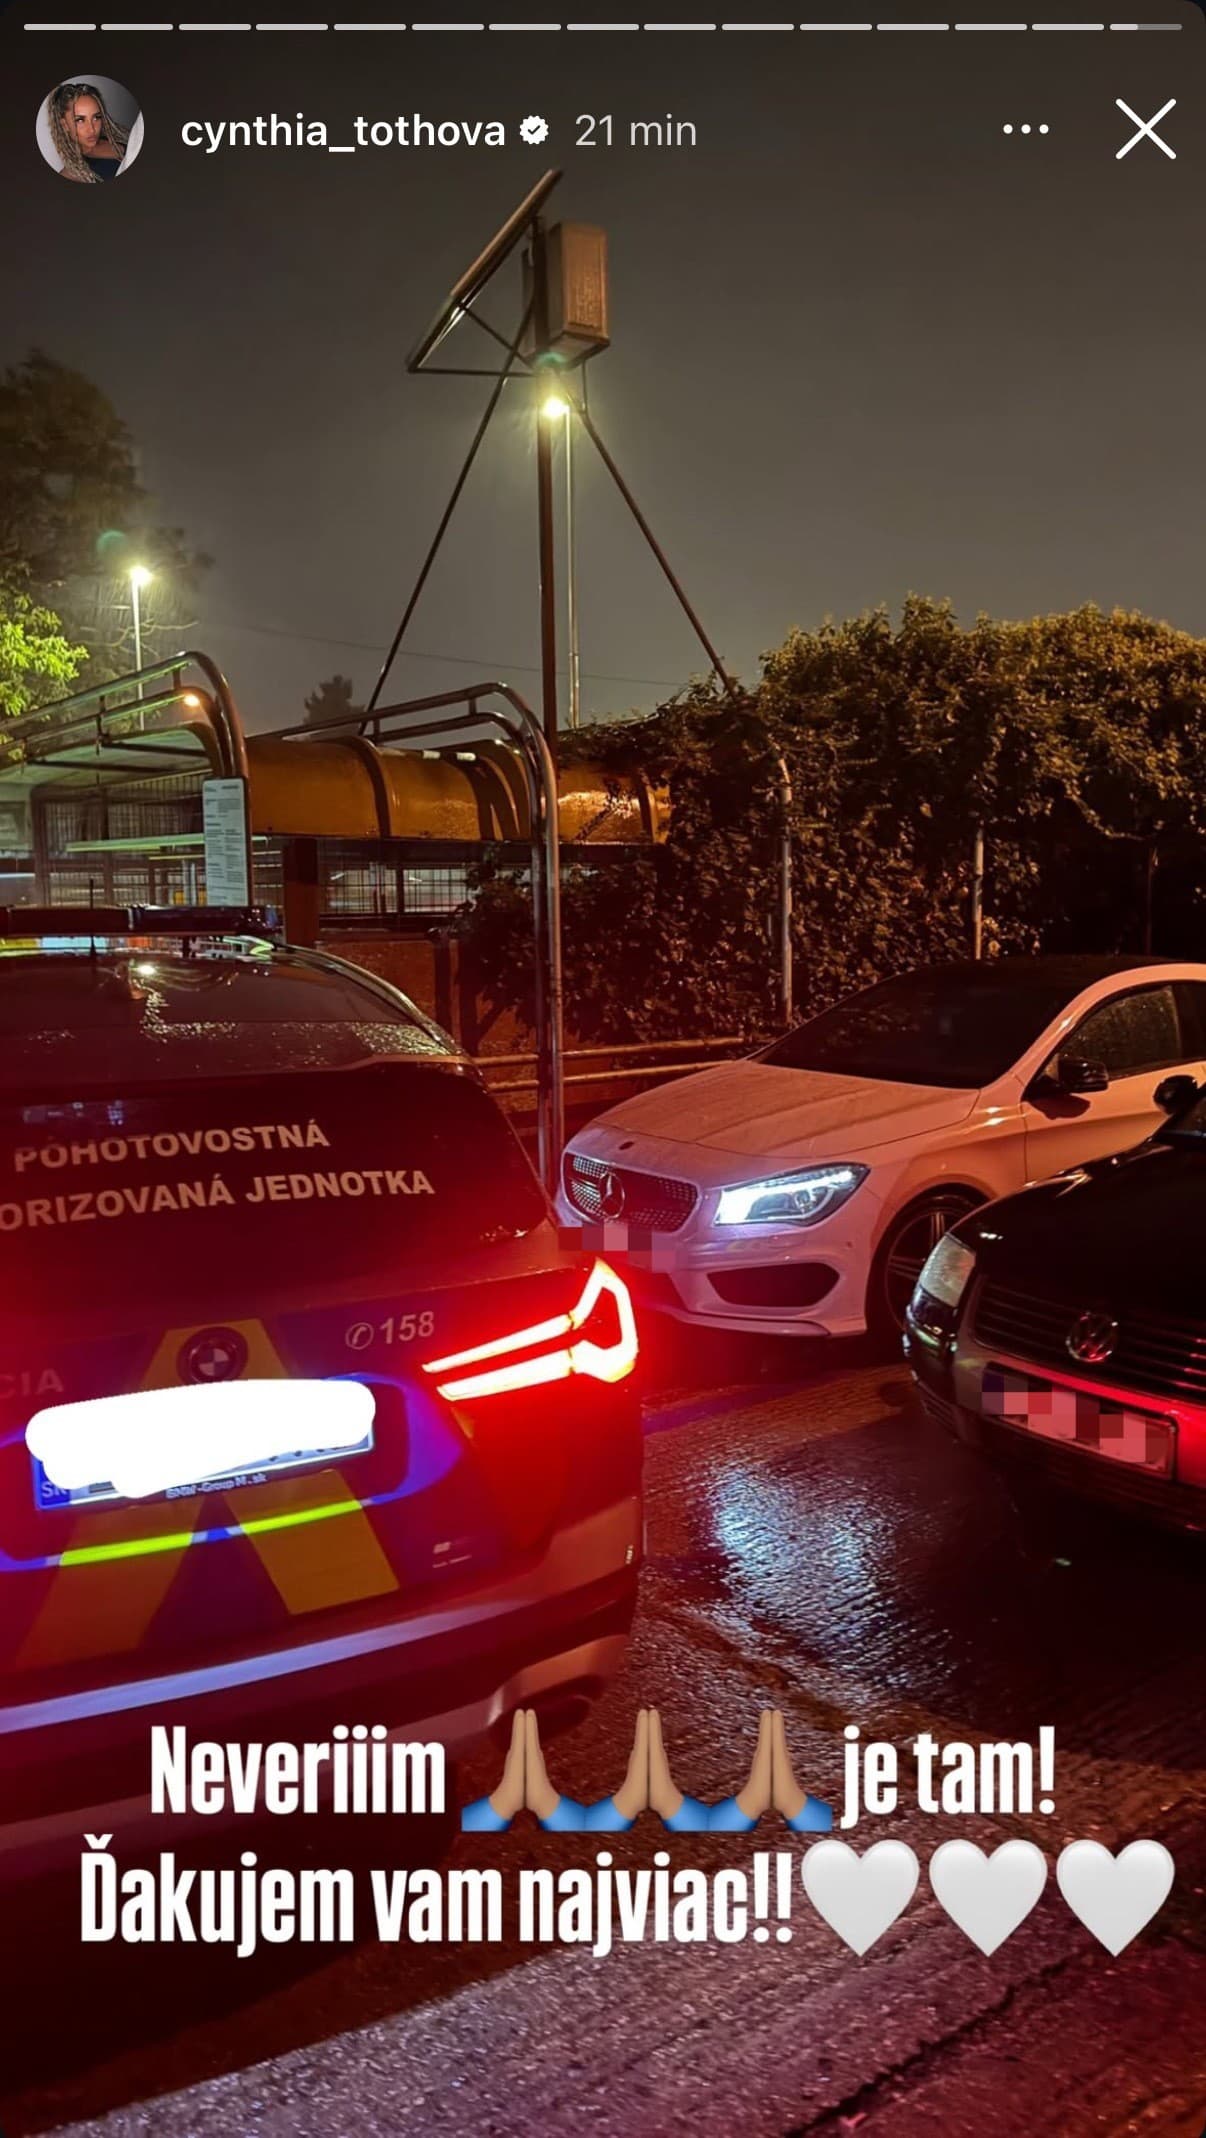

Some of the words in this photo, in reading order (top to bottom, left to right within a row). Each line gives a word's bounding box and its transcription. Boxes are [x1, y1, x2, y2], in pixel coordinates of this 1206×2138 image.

[15, 1119, 331, 1172] POHOTOVOSTNÁ
[245, 1170, 435, 1203] JEDNOTKA
[380, 1310, 435, 1346] 158
